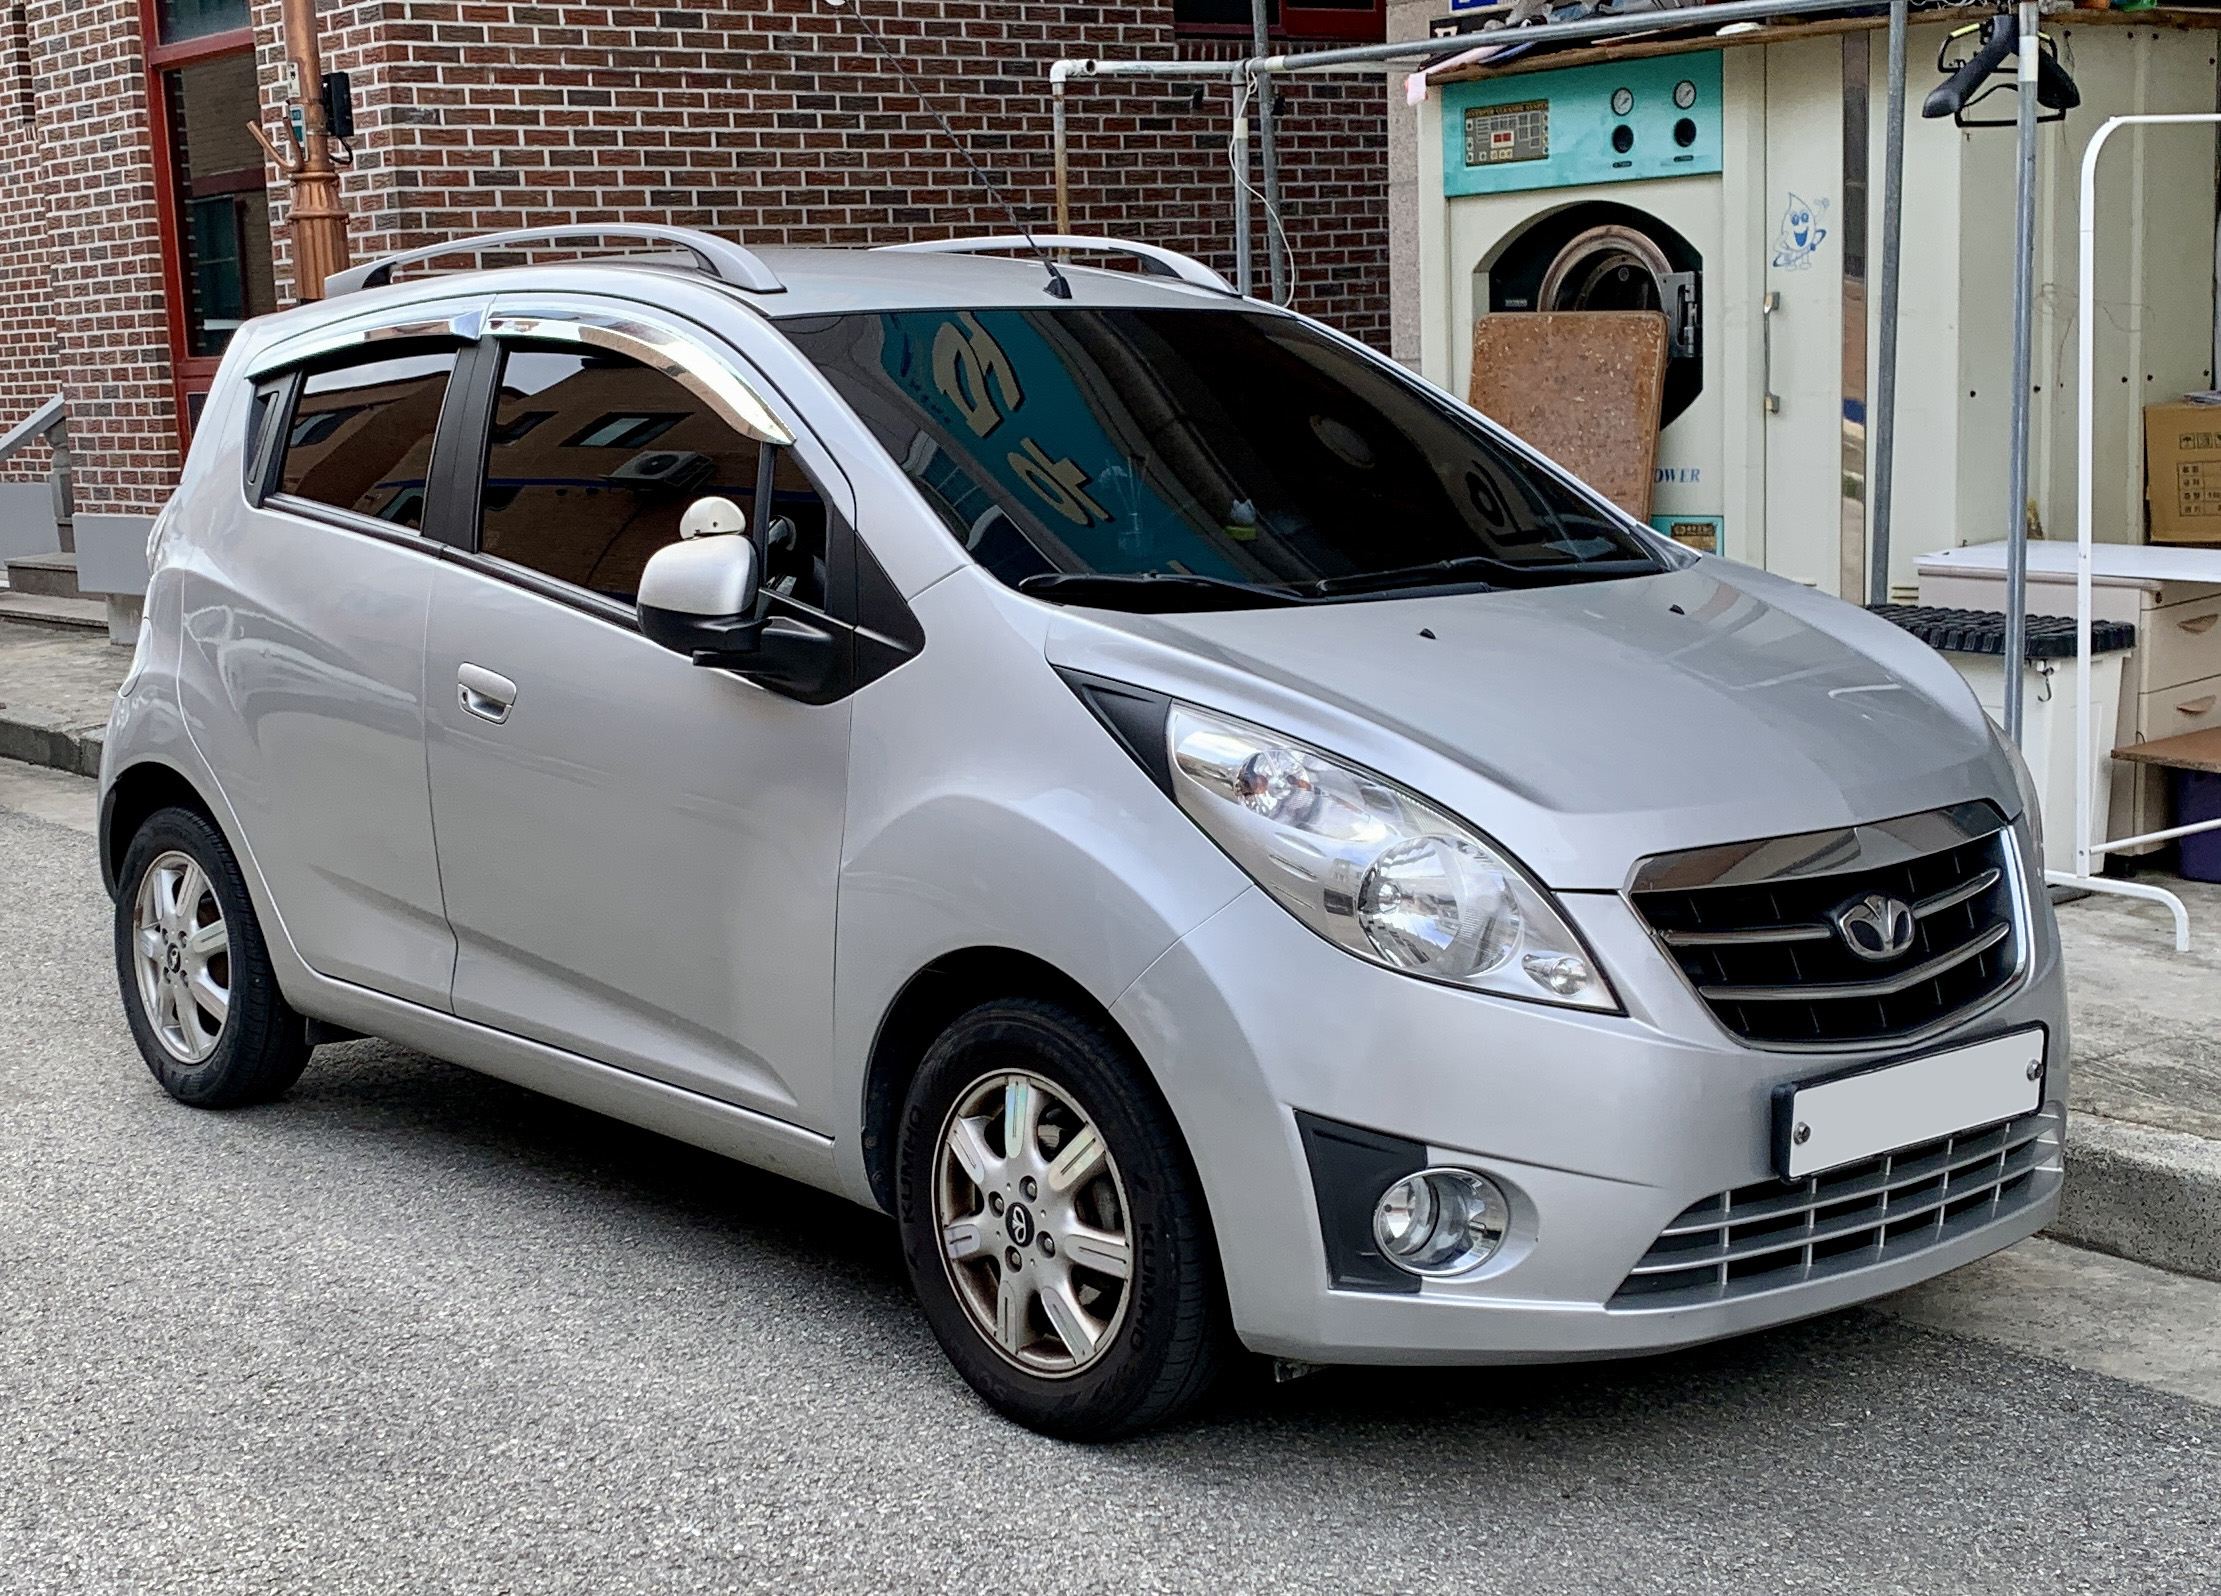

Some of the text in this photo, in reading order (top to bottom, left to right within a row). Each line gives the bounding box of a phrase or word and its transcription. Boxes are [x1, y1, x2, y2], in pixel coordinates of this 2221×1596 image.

[1653, 468, 1701, 483] OWER
[900, 1104, 920, 1224] KUMHO
[1130, 1223, 1156, 1351] KUMHO
